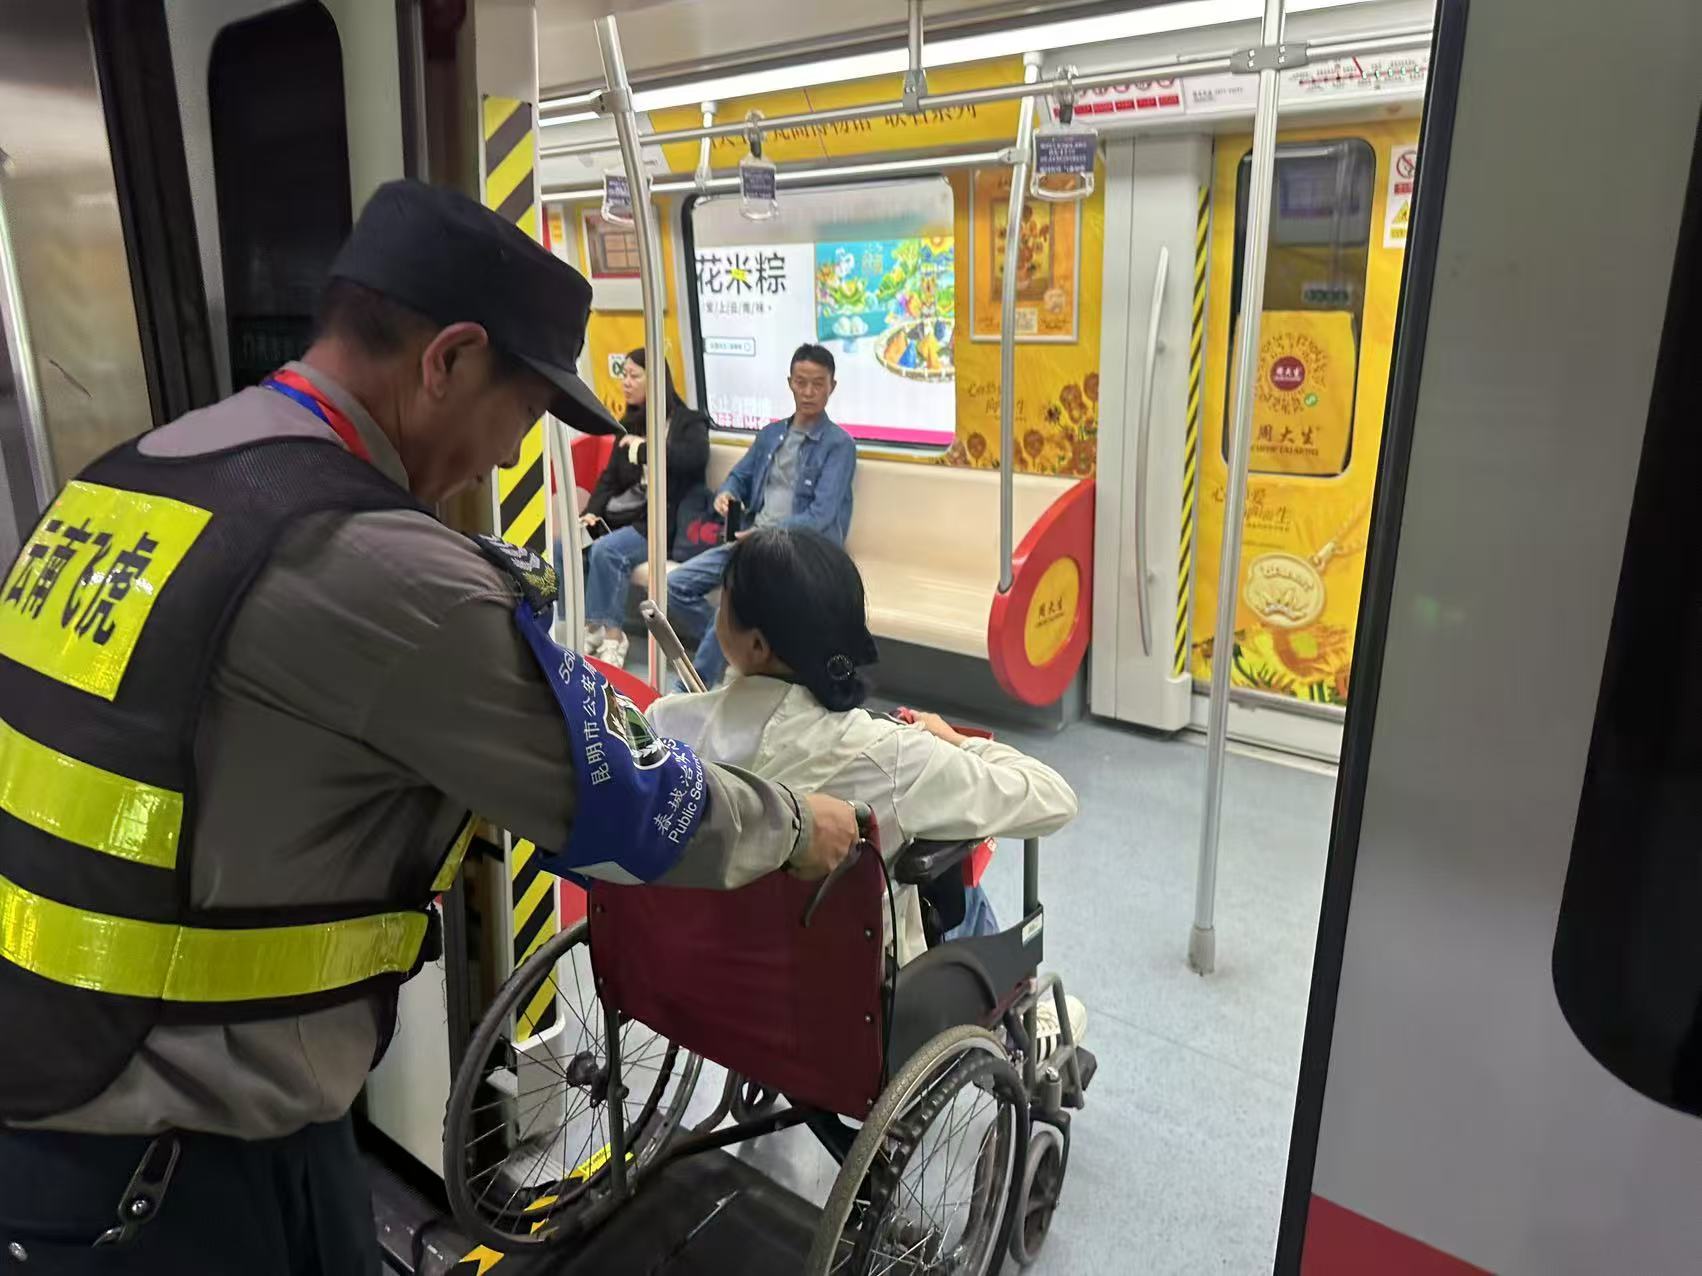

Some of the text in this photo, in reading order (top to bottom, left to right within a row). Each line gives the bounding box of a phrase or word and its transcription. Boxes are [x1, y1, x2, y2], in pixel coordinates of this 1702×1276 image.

[694, 251, 787, 296] 花米粽
[6, 517, 160, 646] 云南飞虎
[667, 802, 698, 843] Public
